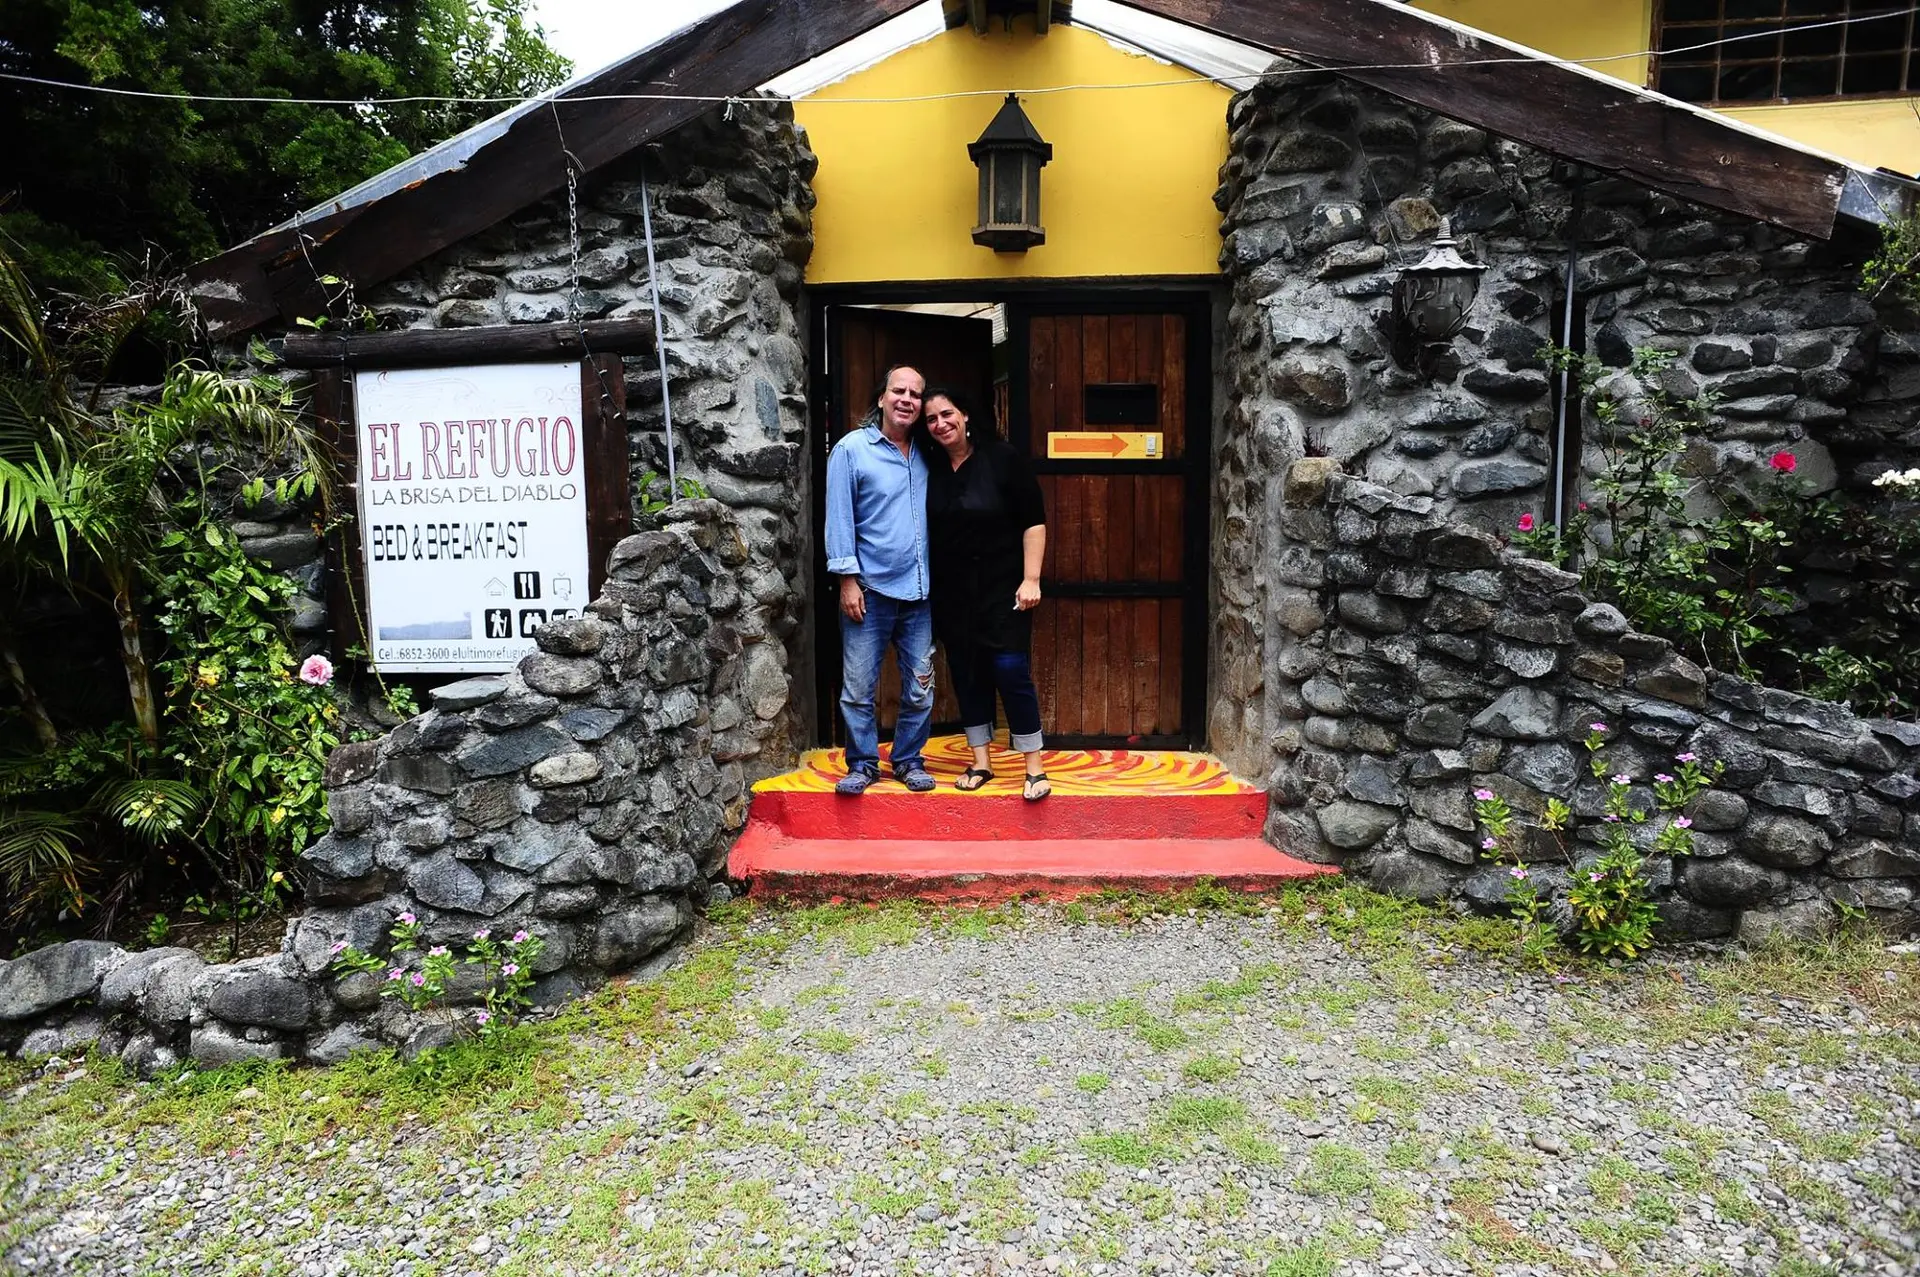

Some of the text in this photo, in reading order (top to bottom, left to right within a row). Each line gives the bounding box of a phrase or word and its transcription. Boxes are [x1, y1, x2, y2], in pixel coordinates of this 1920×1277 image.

[368, 416, 576, 481] EL REFUGIO
[372, 483, 577, 506] LA BRISA DEL DIABLO
[373, 521, 528, 561] BED & BREAKFAST
